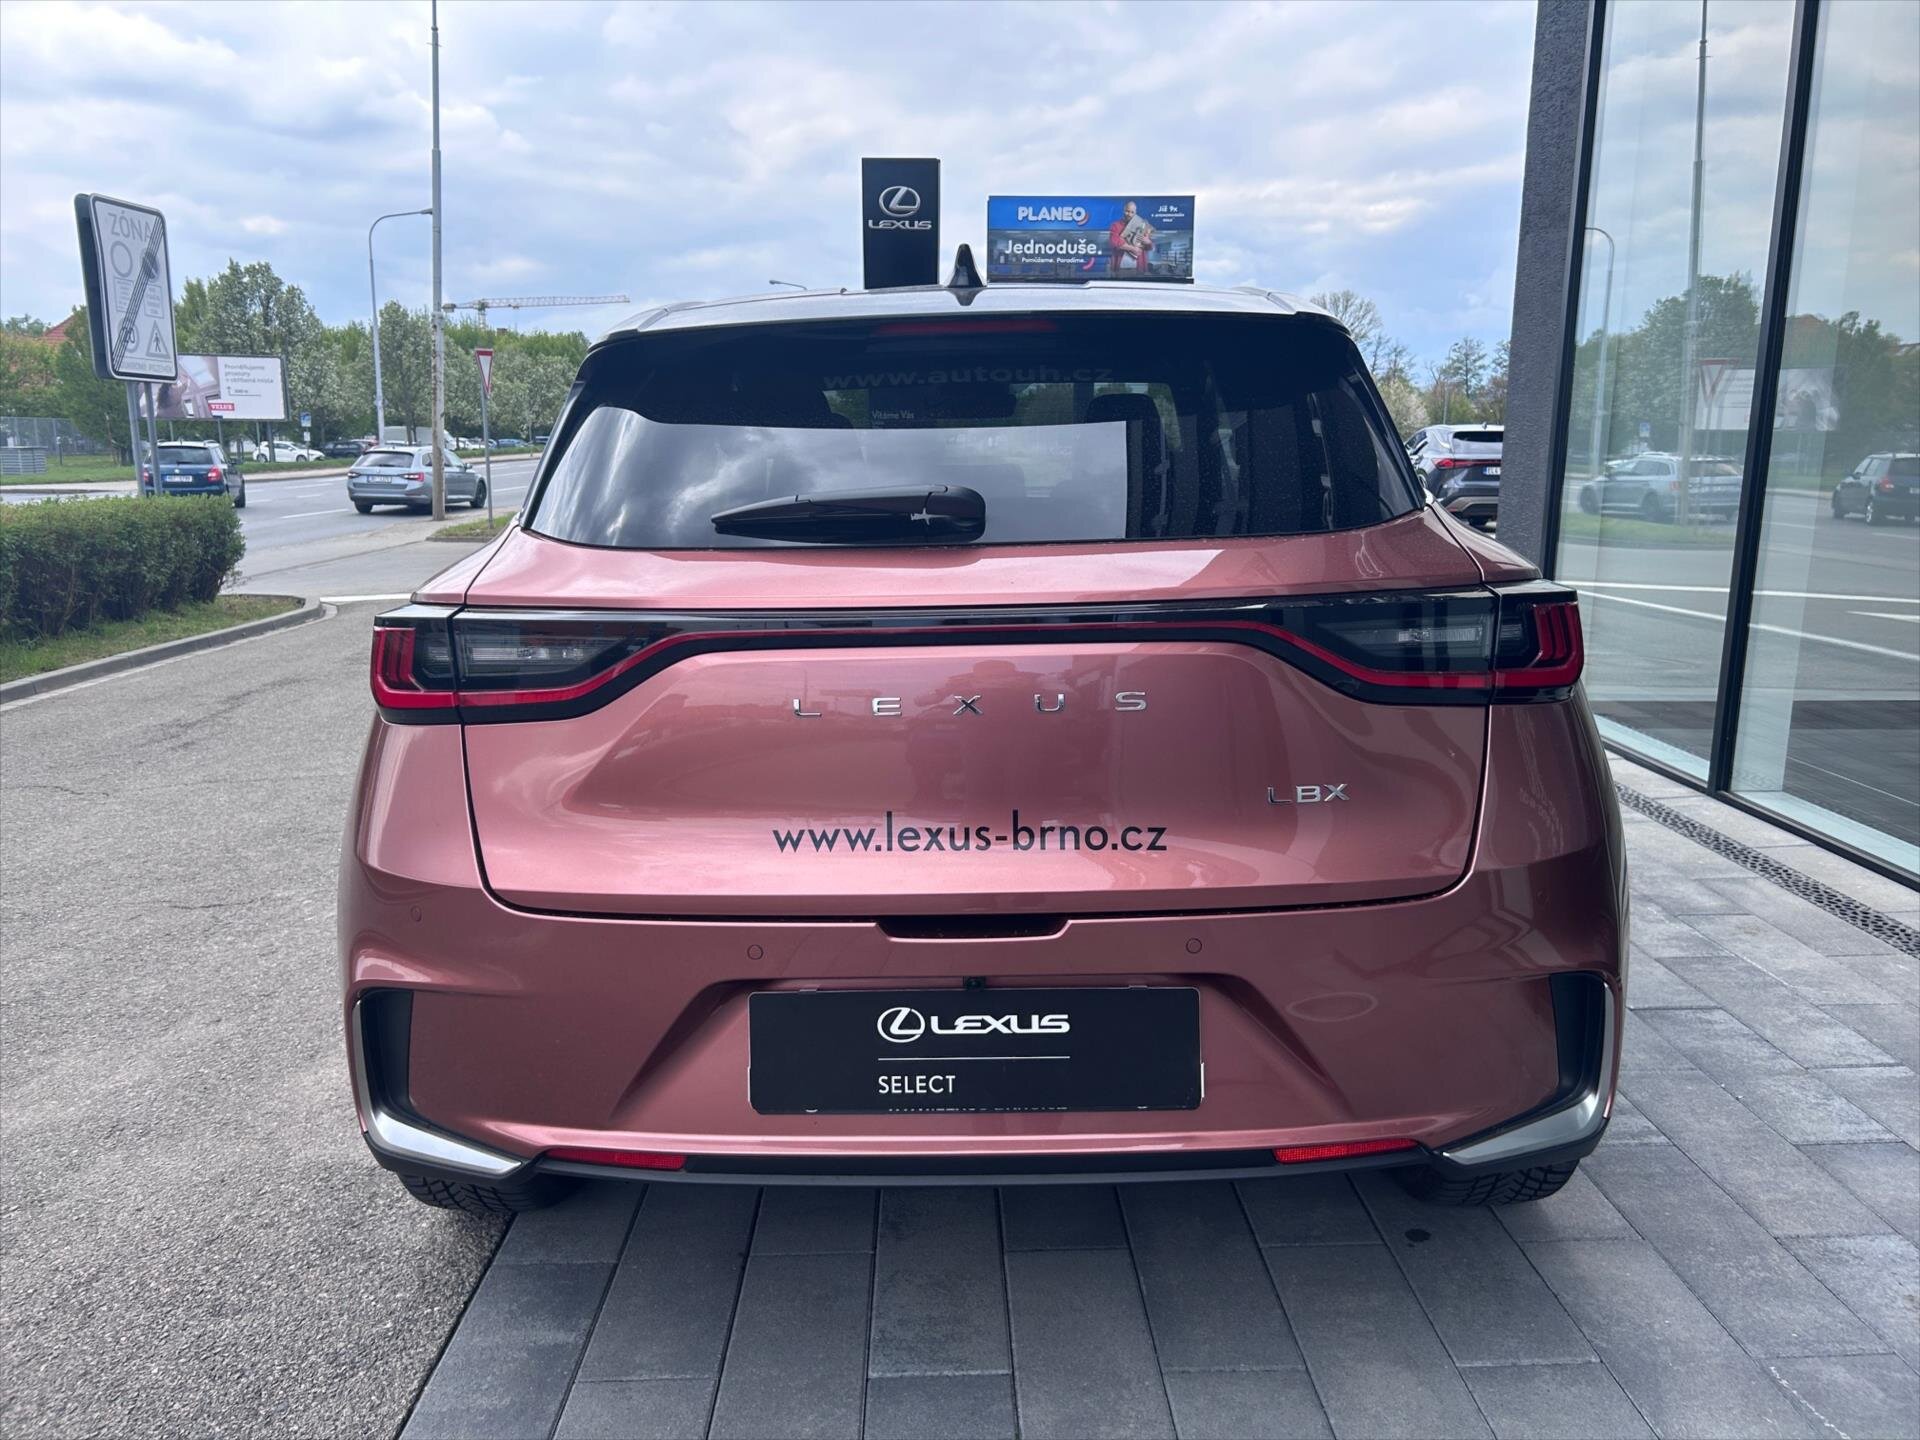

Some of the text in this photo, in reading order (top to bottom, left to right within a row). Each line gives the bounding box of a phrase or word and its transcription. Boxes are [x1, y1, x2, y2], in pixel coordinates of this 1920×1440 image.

[1017, 206, 1087, 221] PLANEO
[868, 219, 932, 230] LEXUS
[1004, 239, 1102, 255] Jednoduše.
[823, 364, 1113, 389] www.autouh.cz
[792, 691, 1147, 718] LEXUS
[1267, 783, 1350, 804] LBX
[772, 810, 1168, 852] www.lexus-brno.cz
[930, 1014, 1071, 1035] LEXUS
[878, 1075, 956, 1094] SELECT
